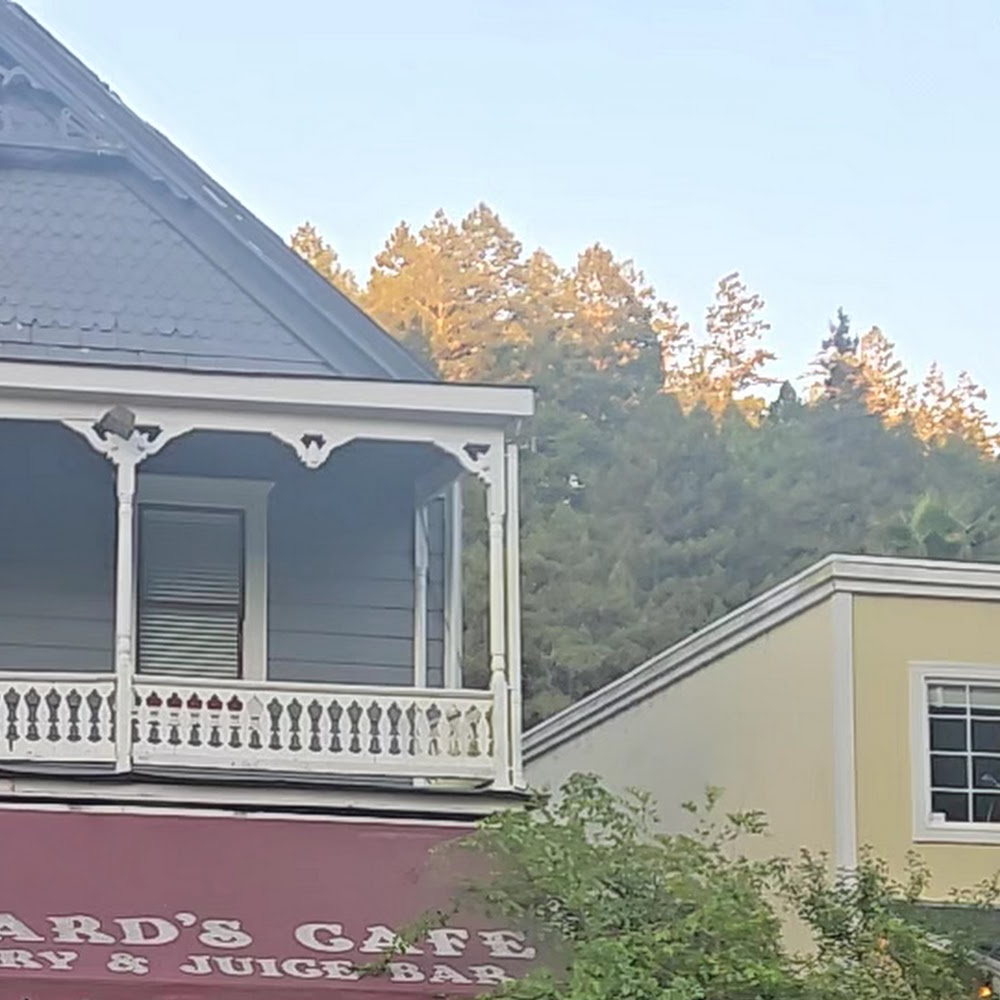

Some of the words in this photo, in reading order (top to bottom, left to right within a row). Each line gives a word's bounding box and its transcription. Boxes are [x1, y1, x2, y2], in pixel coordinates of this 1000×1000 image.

[295, 922, 536, 960] CAFE
[106, 952, 150, 975] &
[179, 954, 360, 981] JUICE
[389, 961, 513, 985] BAR
